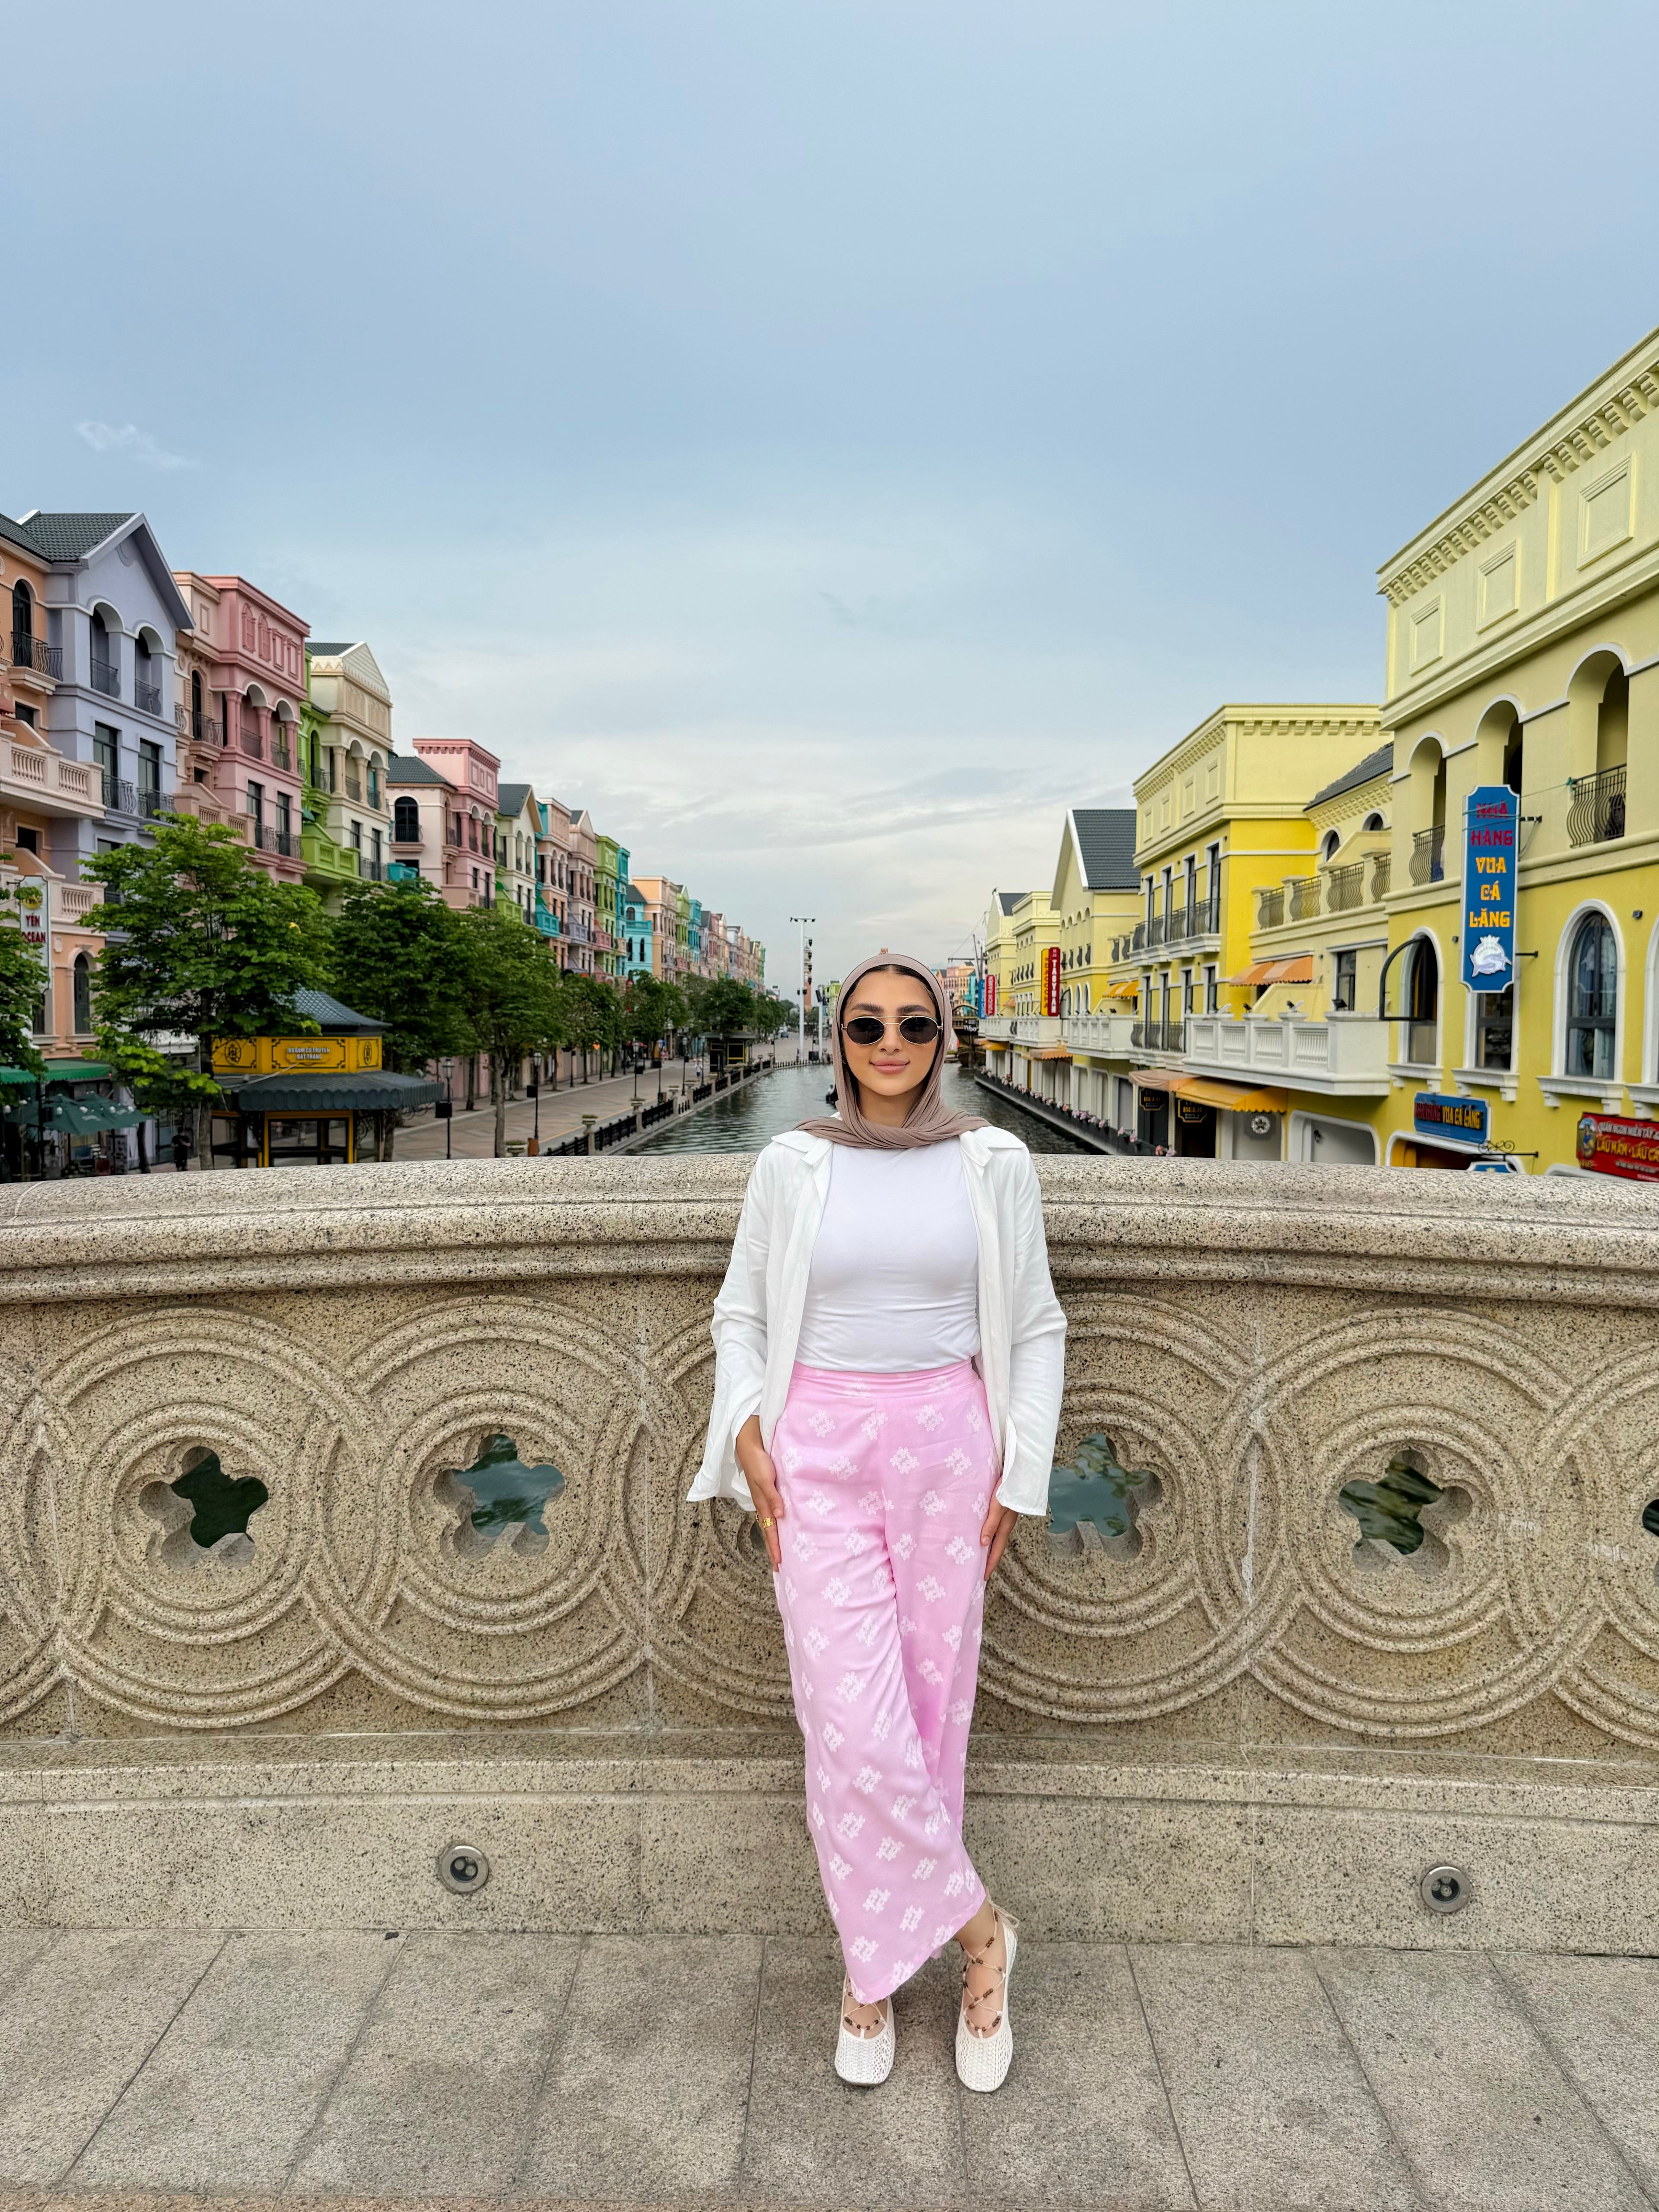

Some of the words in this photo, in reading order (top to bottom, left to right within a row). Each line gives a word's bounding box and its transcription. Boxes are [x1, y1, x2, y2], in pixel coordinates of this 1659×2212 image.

[1470, 826, 1513, 846] HÀNG
[1475, 857, 1507, 874] VUA
[1481, 880, 1501, 900] CÁ
[1469, 908, 1510, 928] LĂNG
